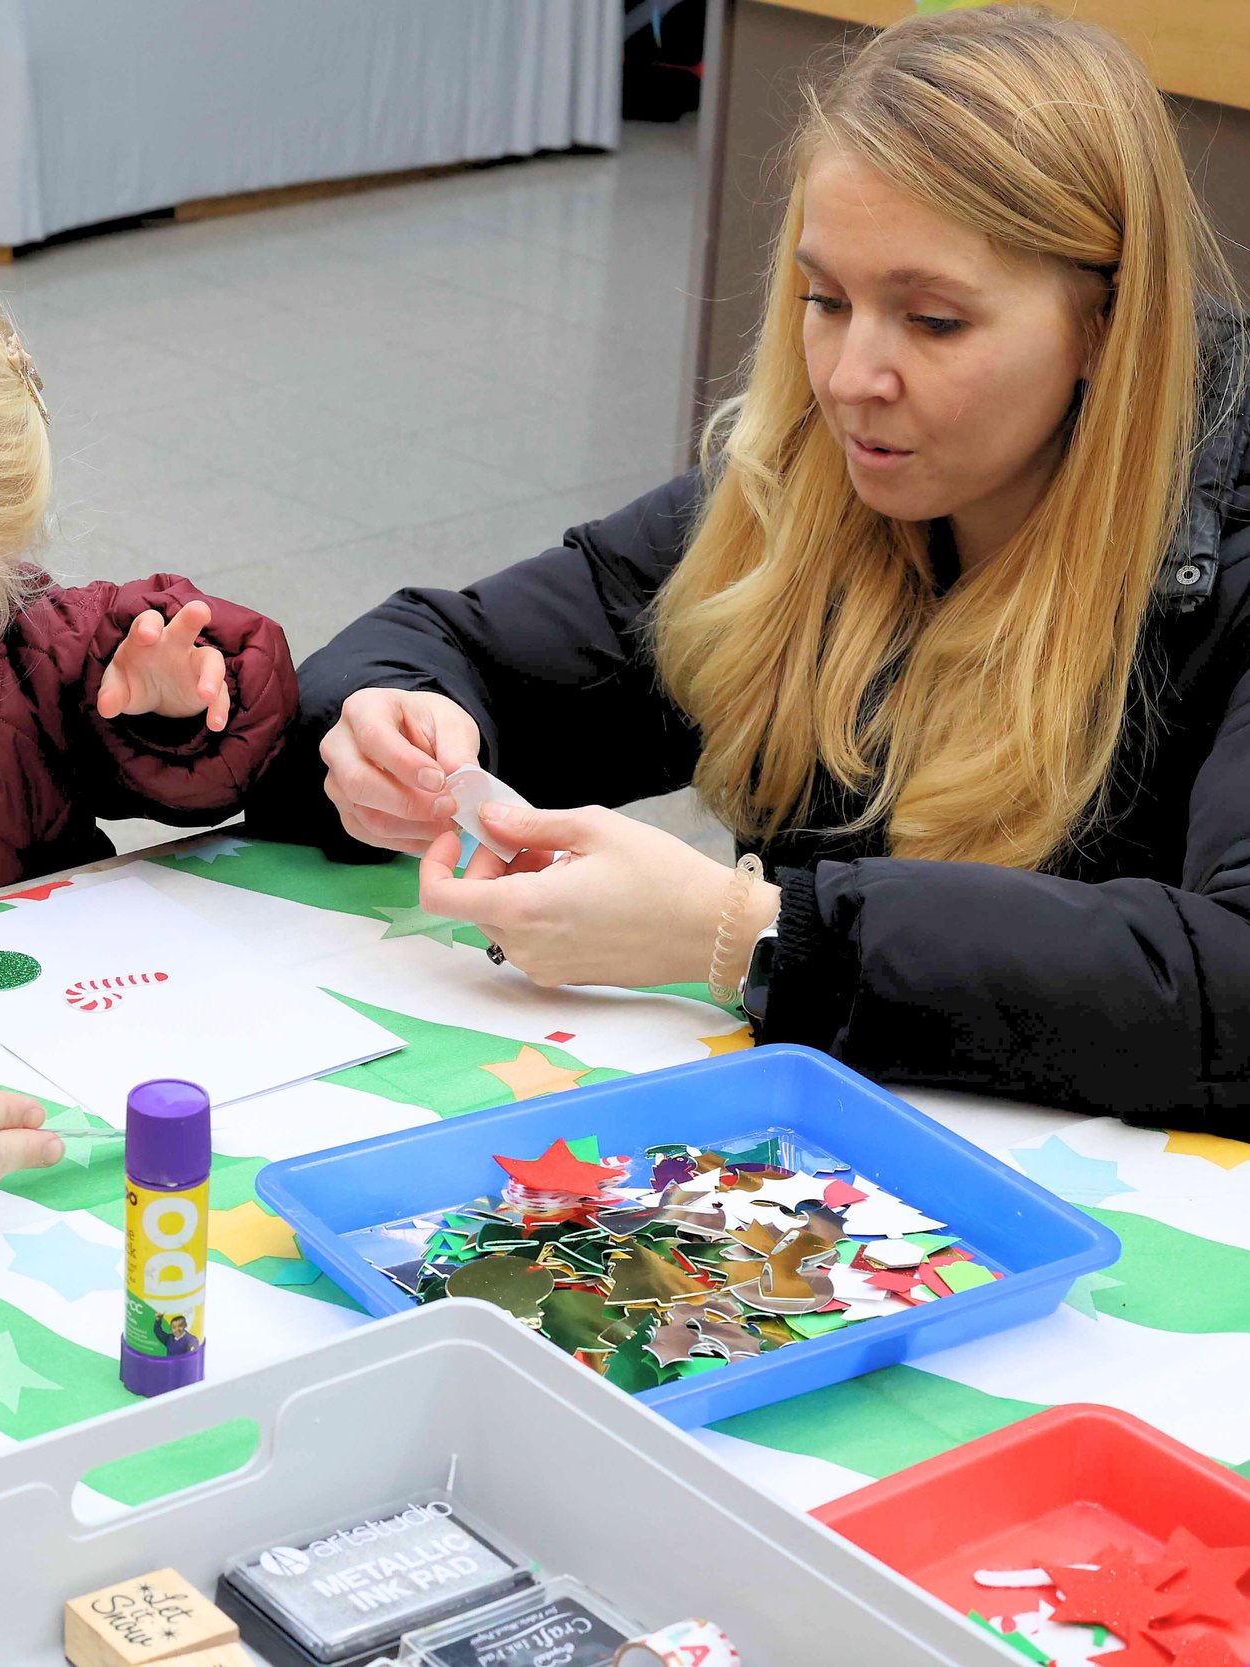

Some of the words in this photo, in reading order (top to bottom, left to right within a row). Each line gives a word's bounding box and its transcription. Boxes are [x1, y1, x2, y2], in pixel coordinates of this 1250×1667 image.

[309, 1501, 453, 1558] artstudio
[312, 1532, 472, 1598] METALLIC
[347, 1576, 413, 1613] INK
[406, 1555, 479, 1591] PAD
[91, 1594, 154, 1648] Snow
[130, 1608, 155, 1625] it
[144, 1589, 194, 1625] Let
[531, 1617, 592, 1648] Craft
